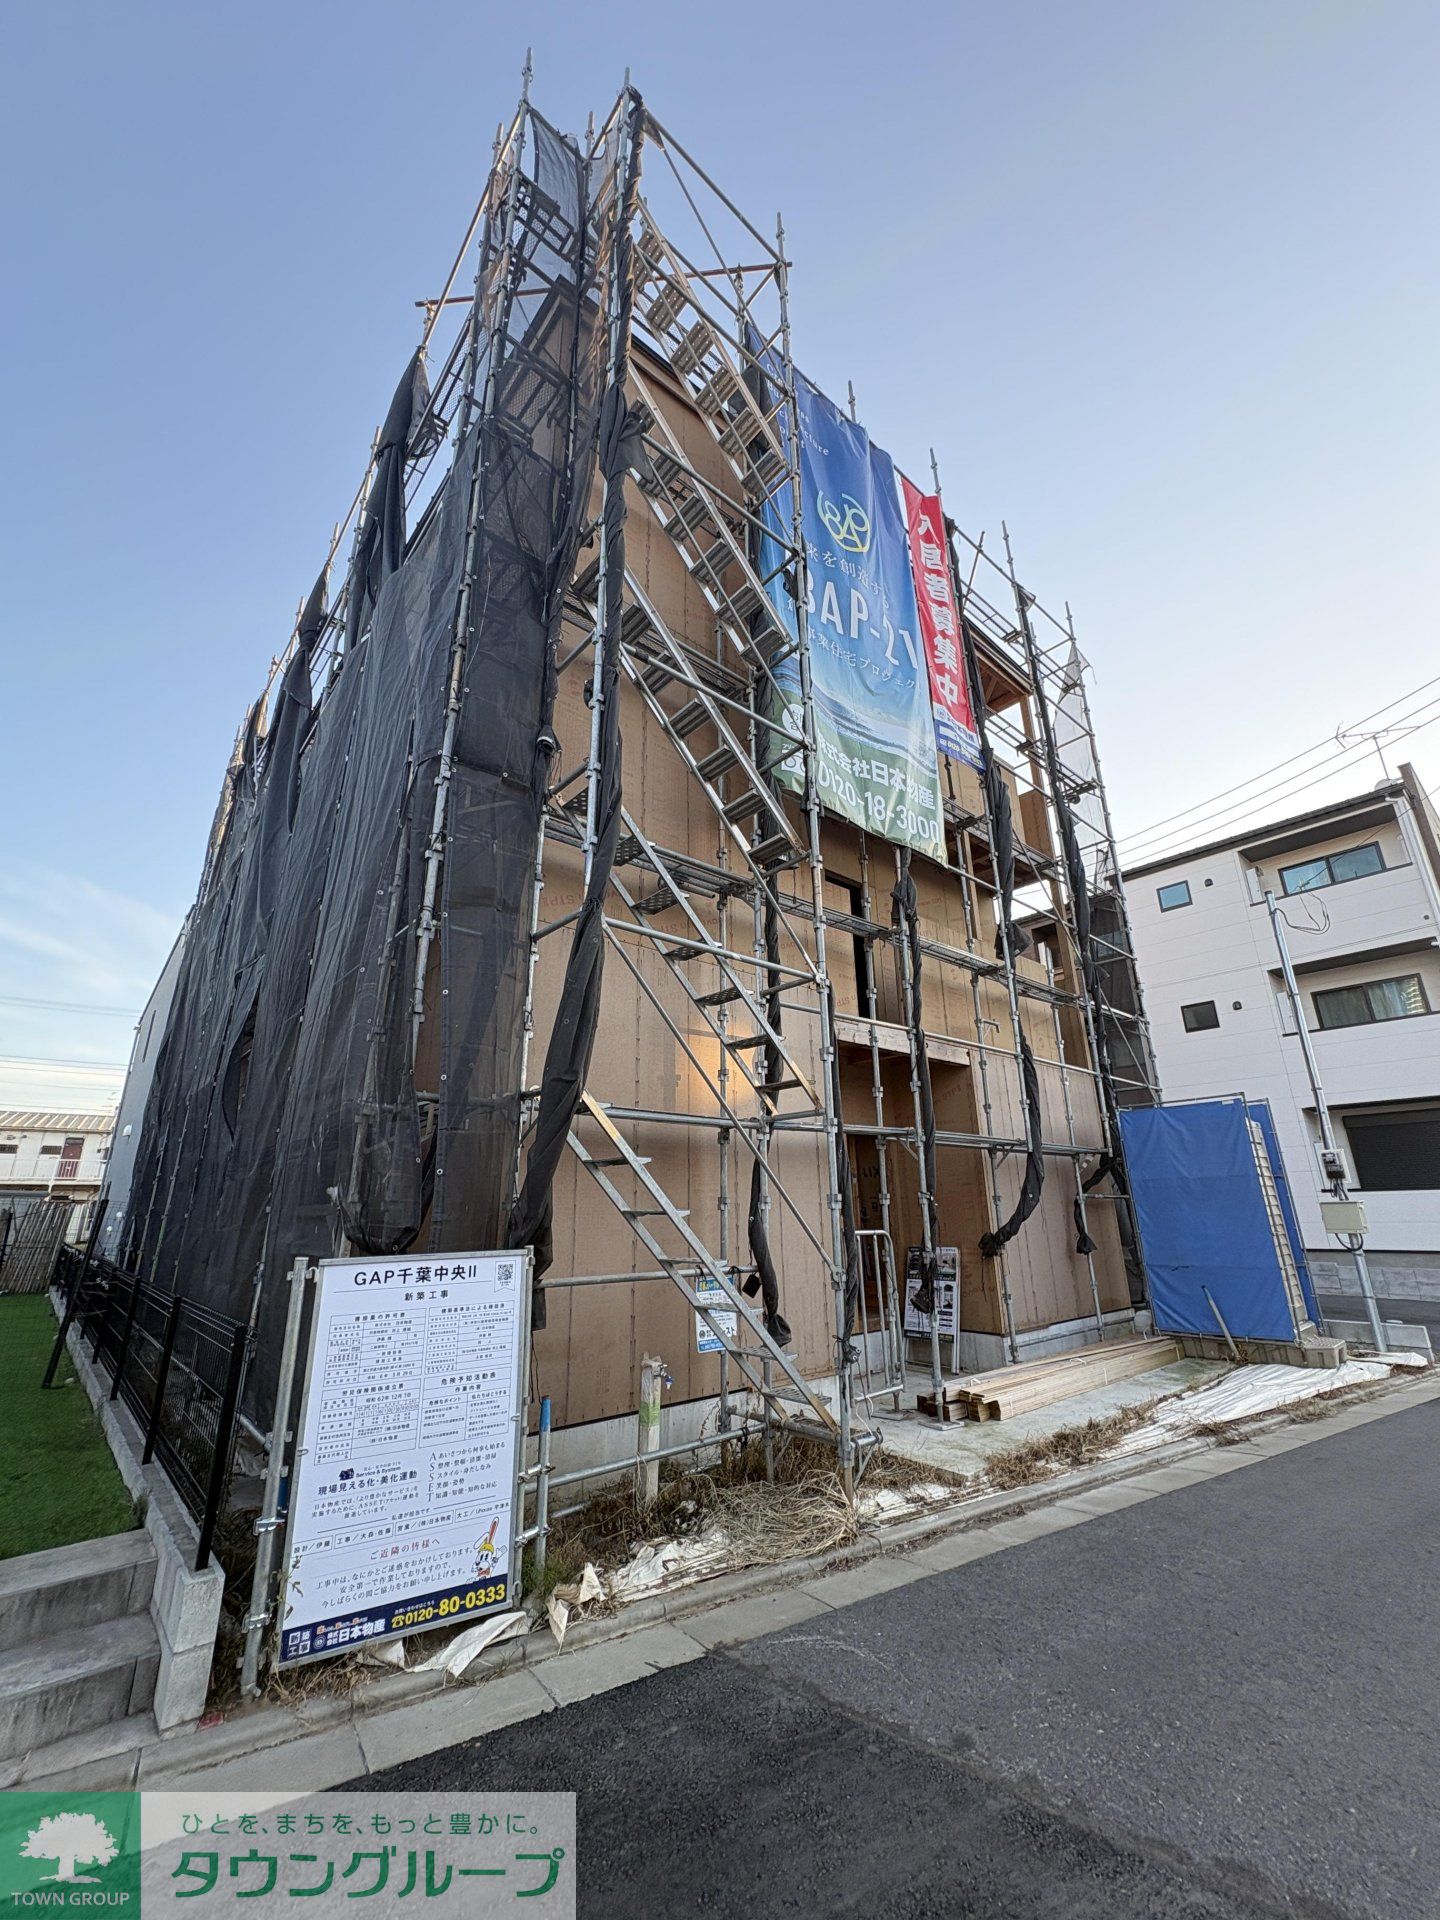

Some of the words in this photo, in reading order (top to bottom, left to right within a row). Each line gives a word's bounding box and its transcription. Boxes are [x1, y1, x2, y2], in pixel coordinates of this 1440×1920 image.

[818, 760, 941, 845] 0120-18-3000
[404, 1290, 449, 1301] 新築工事
[441, 1371, 496, 1386] 危険予知活動表
[318, 1470, 418, 1496] 現場見える化・美化運動
[370, 1538, 441, 1561] ご近隣の皆様へ
[404, 1583, 506, 1626] 0120-80-0333
[338, 1618, 386, 1643] 日本物産
